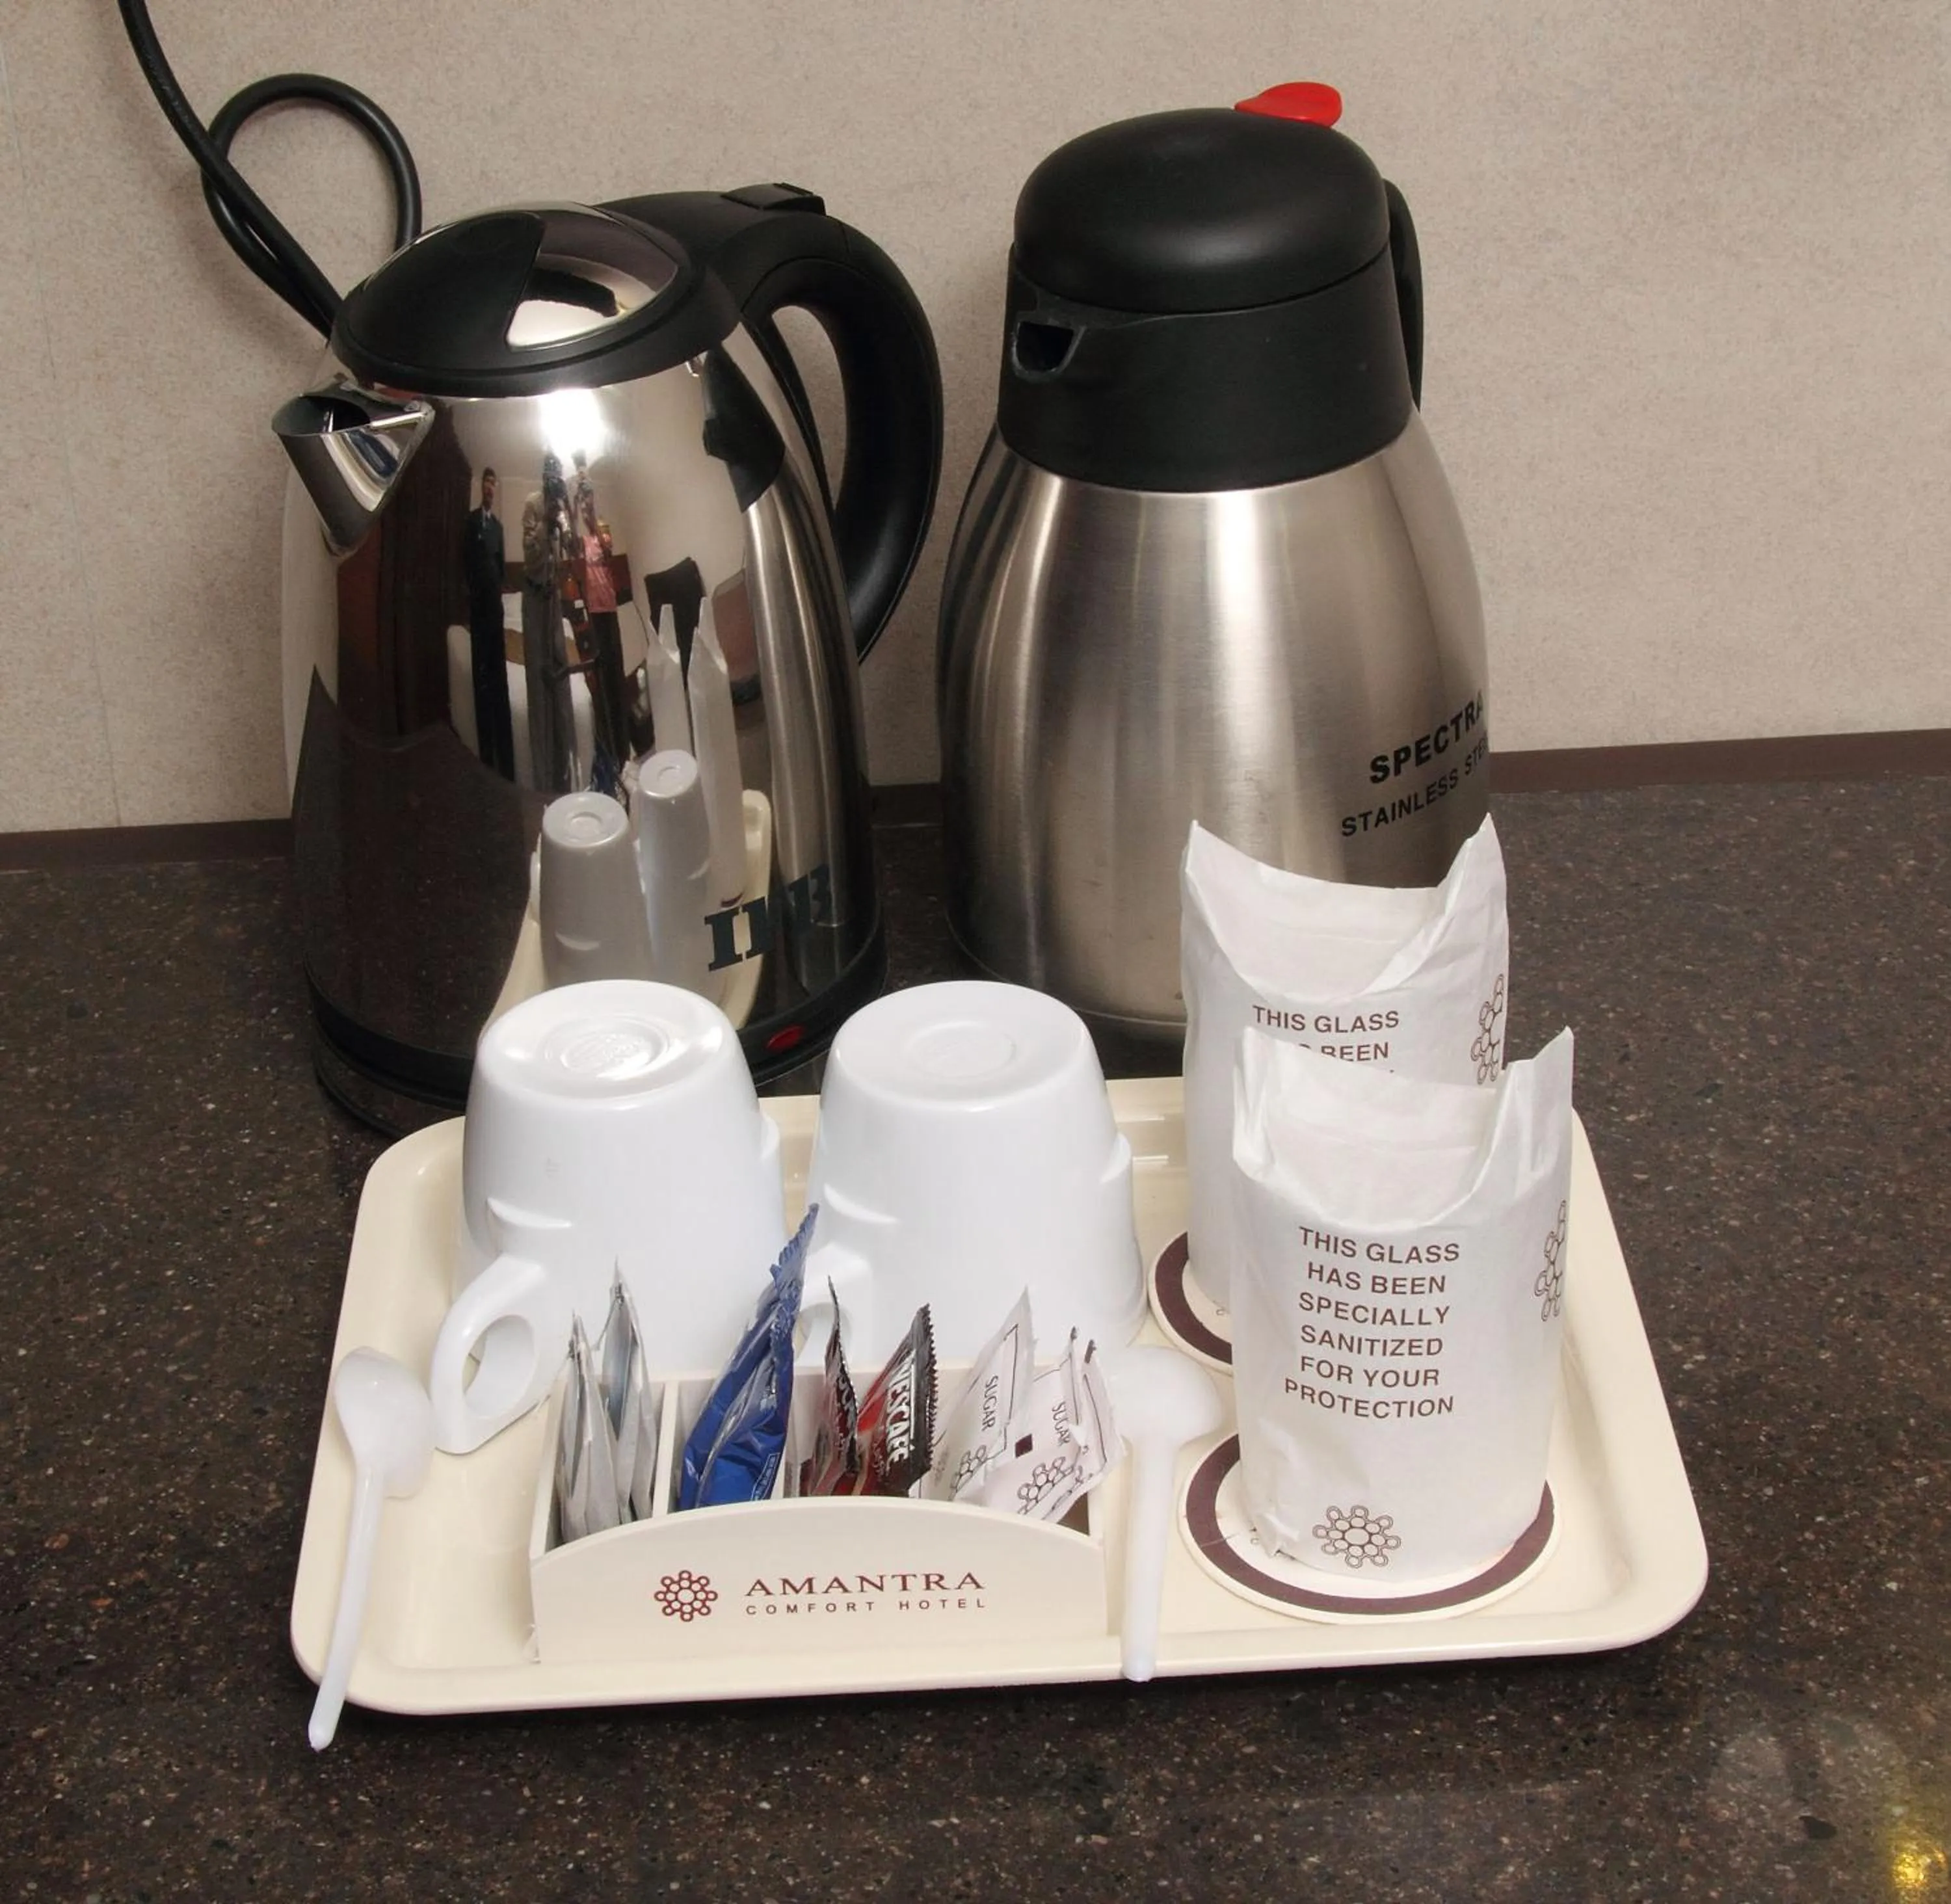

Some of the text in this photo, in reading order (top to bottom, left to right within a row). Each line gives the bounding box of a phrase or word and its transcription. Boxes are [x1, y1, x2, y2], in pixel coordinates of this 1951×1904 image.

[1370, 689, 1483, 784] SPECTRA
[1342, 768, 1459, 837] STAINLESS
[1252, 1005, 1400, 1033] THIS GLASS
[1299, 1226, 1460, 1263] THIS GLASS
[1308, 1262, 1446, 1295] HAS BEEN
[1299, 1291, 1450, 1326] SPECIALLY
[1300, 1324, 1444, 1356] SANITIZED
[1300, 1356, 1440, 1388] FOR YOUR
[981, 1375, 1000, 1431] SUGAR
[1284, 1378, 1454, 1420] PROTECTION
[745, 1572, 986, 1597] AMANTRA
[745, 1597, 986, 1616] COMFORT HOTEL
